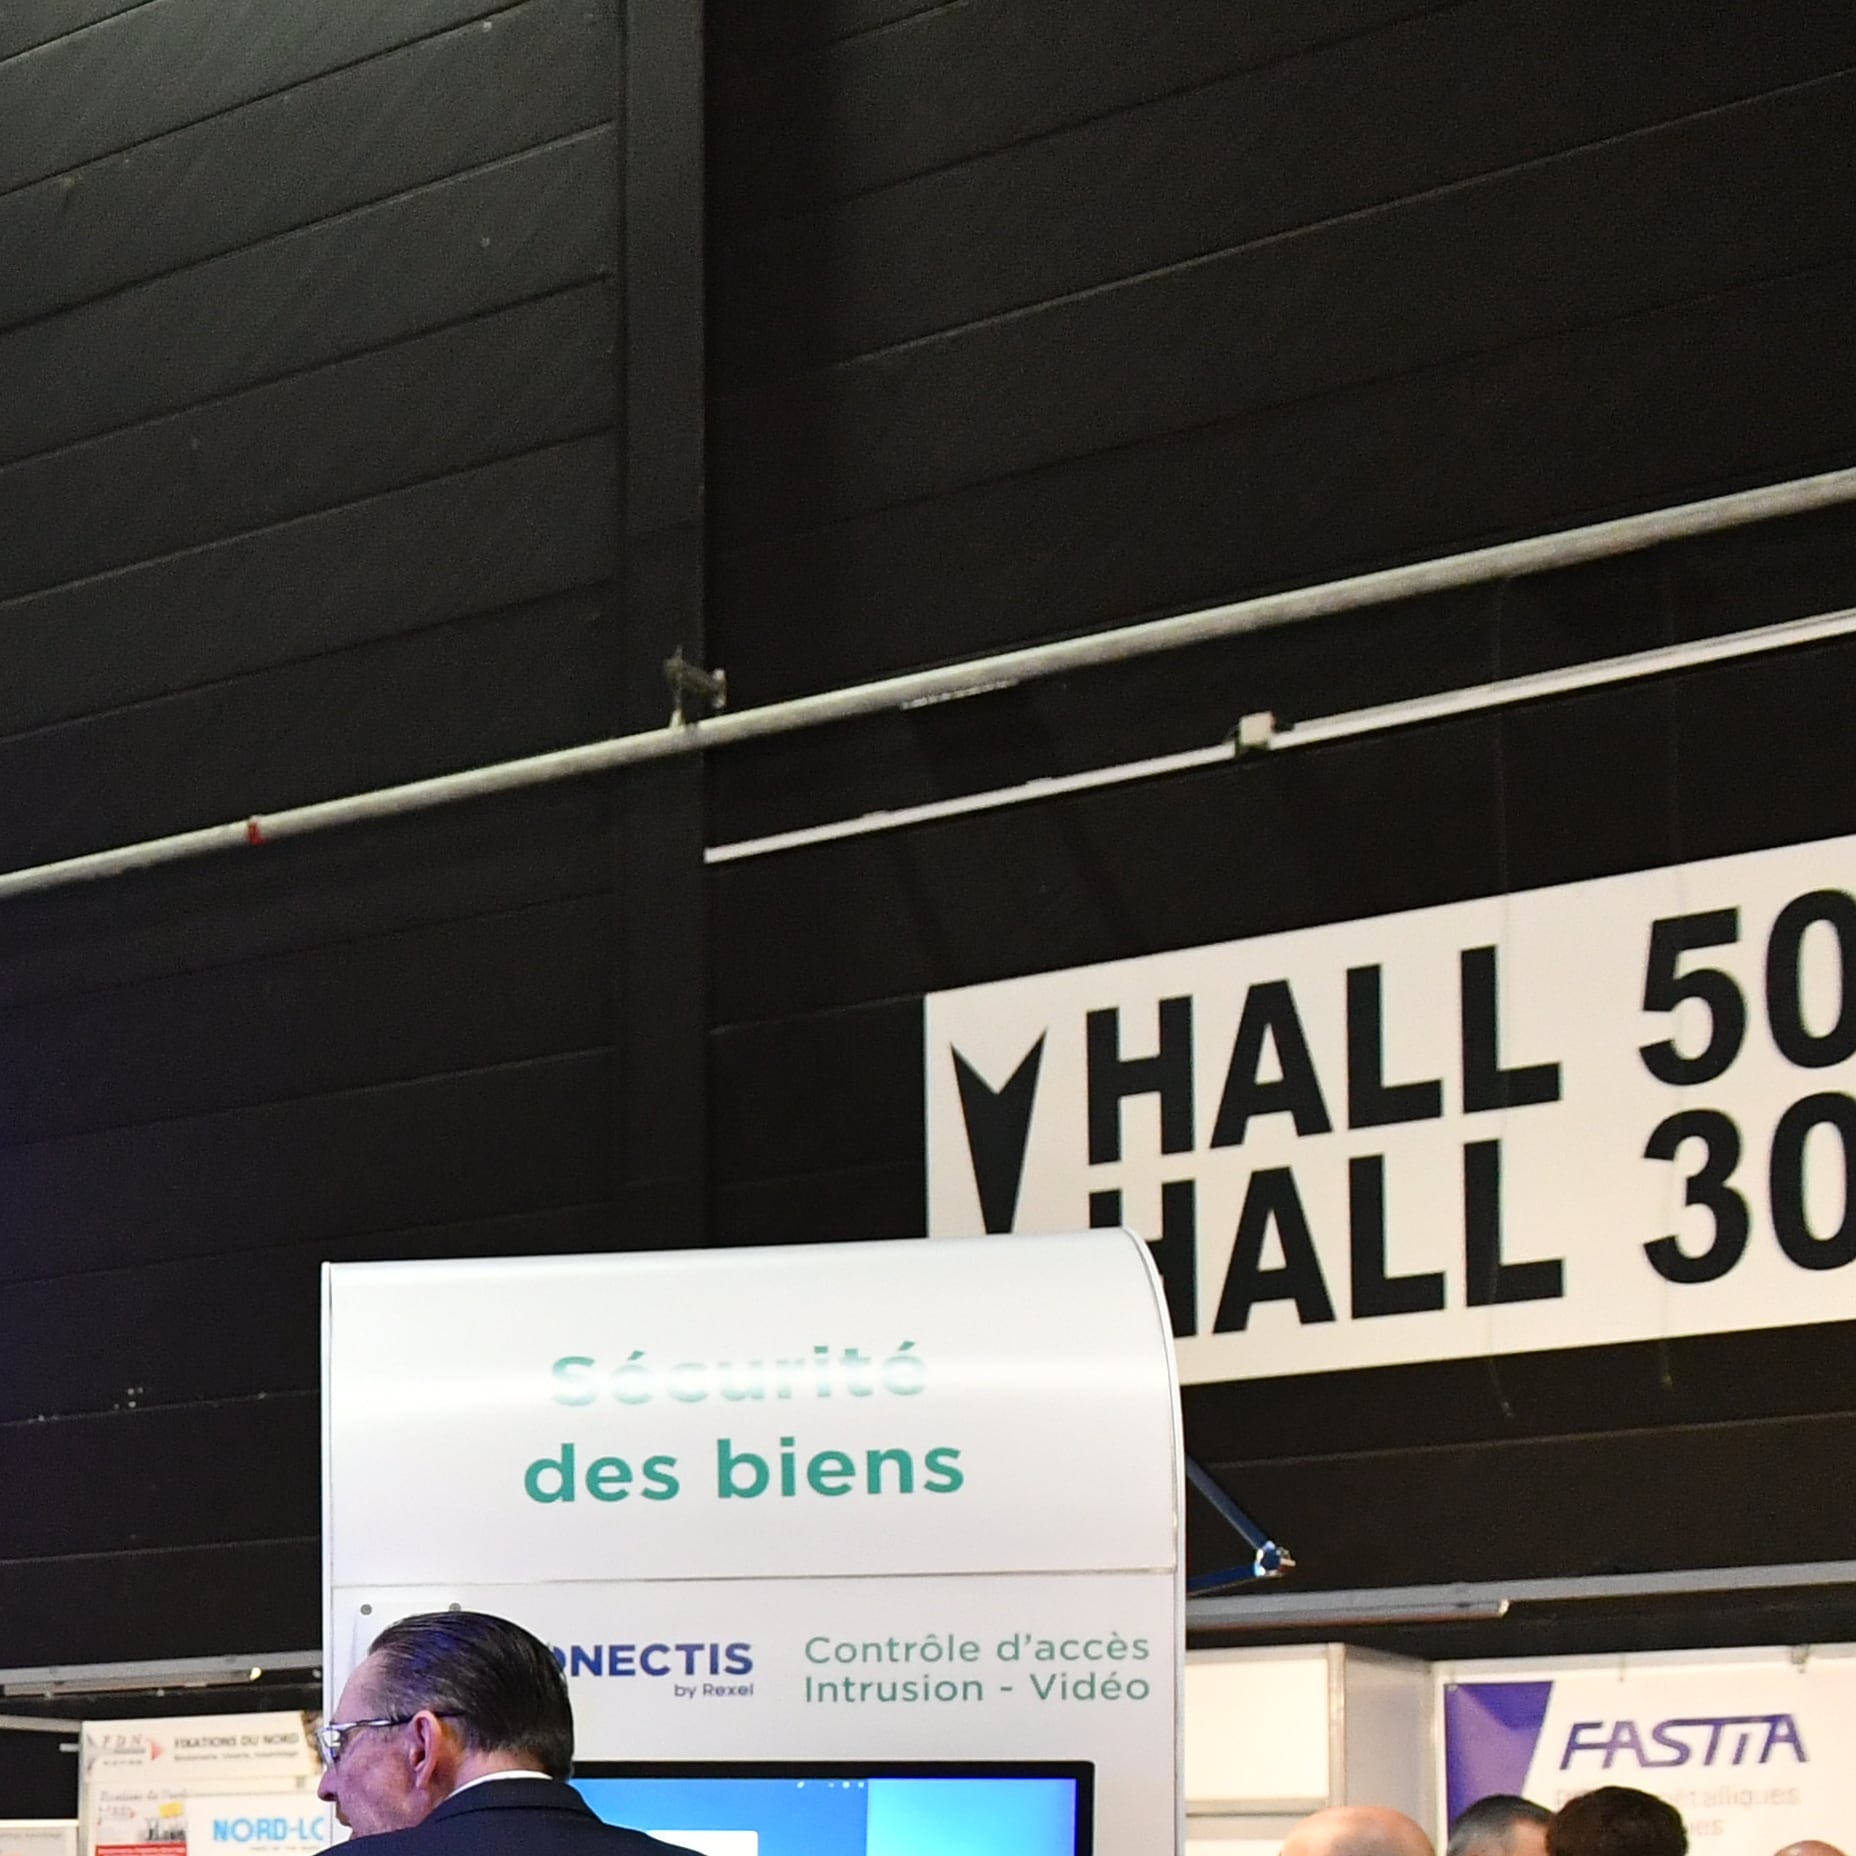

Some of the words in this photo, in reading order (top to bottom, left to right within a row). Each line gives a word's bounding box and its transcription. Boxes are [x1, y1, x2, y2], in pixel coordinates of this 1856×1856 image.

[1086, 944, 1562, 1166] HALL
[1637, 887, 1856, 1088] 50
[1642, 1091, 1856, 1287] 30
[551, 1340, 928, 1407] Sécurité
[524, 1442, 681, 1504] des
[716, 1436, 965, 1500] biens
[557, 1643, 754, 1677] NECTIS
[805, 1633, 981, 1664] Contrôle
[996, 1631, 1150, 1663] d'accès
[674, 1683, 698, 1699] by
[701, 1684, 754, 1697] Rexel
[805, 1675, 985, 1703] Intrusion
[1029, 1672, 1151, 1703] Vidéo
